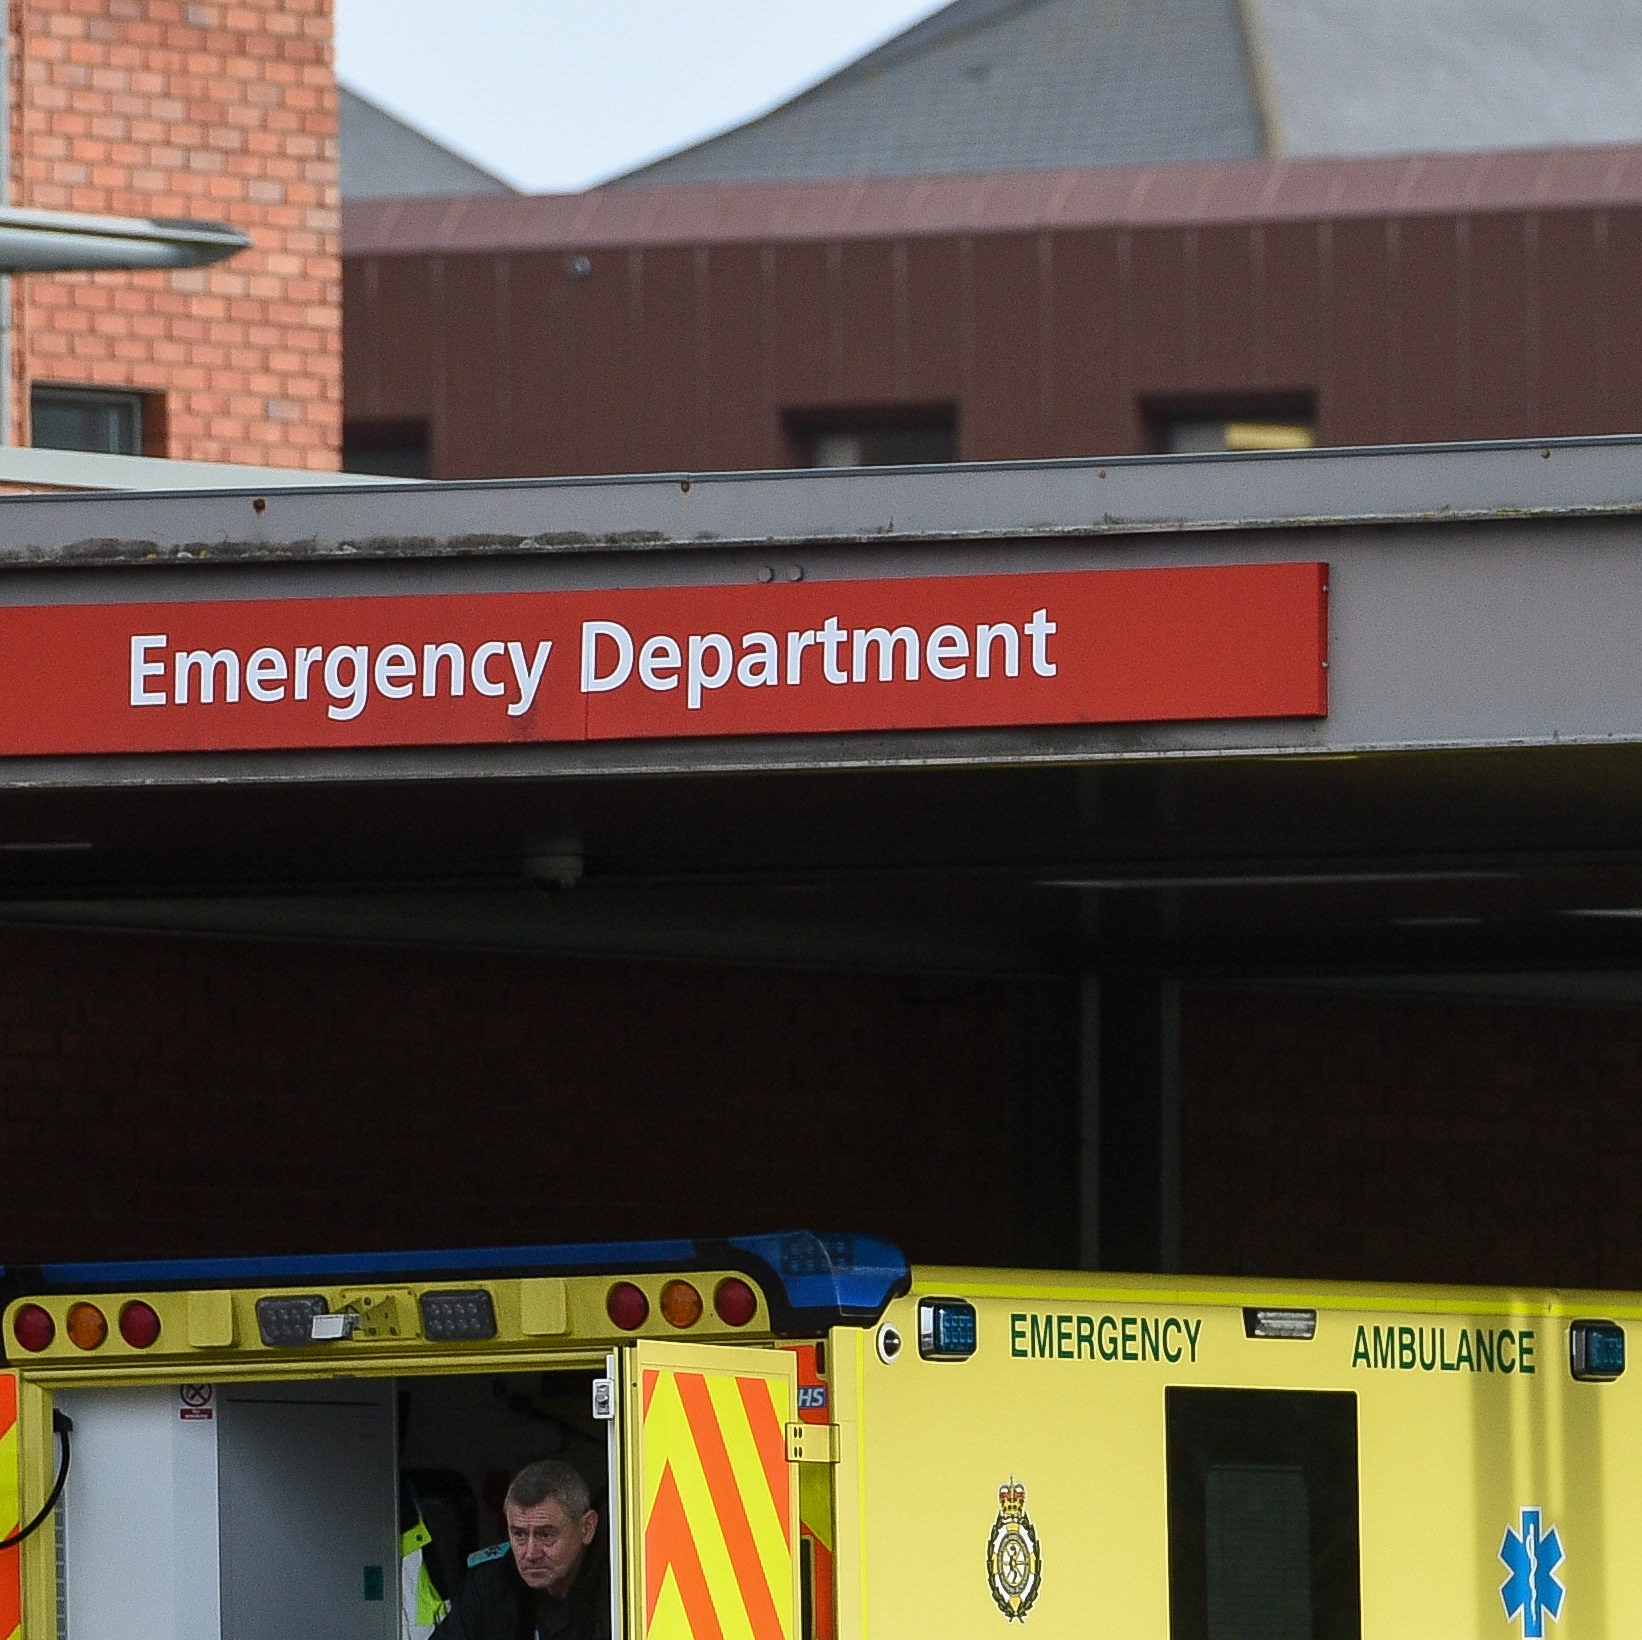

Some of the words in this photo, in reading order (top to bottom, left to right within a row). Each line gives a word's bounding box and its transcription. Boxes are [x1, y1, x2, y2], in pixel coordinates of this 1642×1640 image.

[130, 634, 555, 721] Emergency
[580, 608, 1059, 710] Department
[1010, 1312, 1202, 1365] EMERGENCY
[1352, 1324, 1537, 1375] AMBULANCE
[798, 1387, 825, 1407] HS
